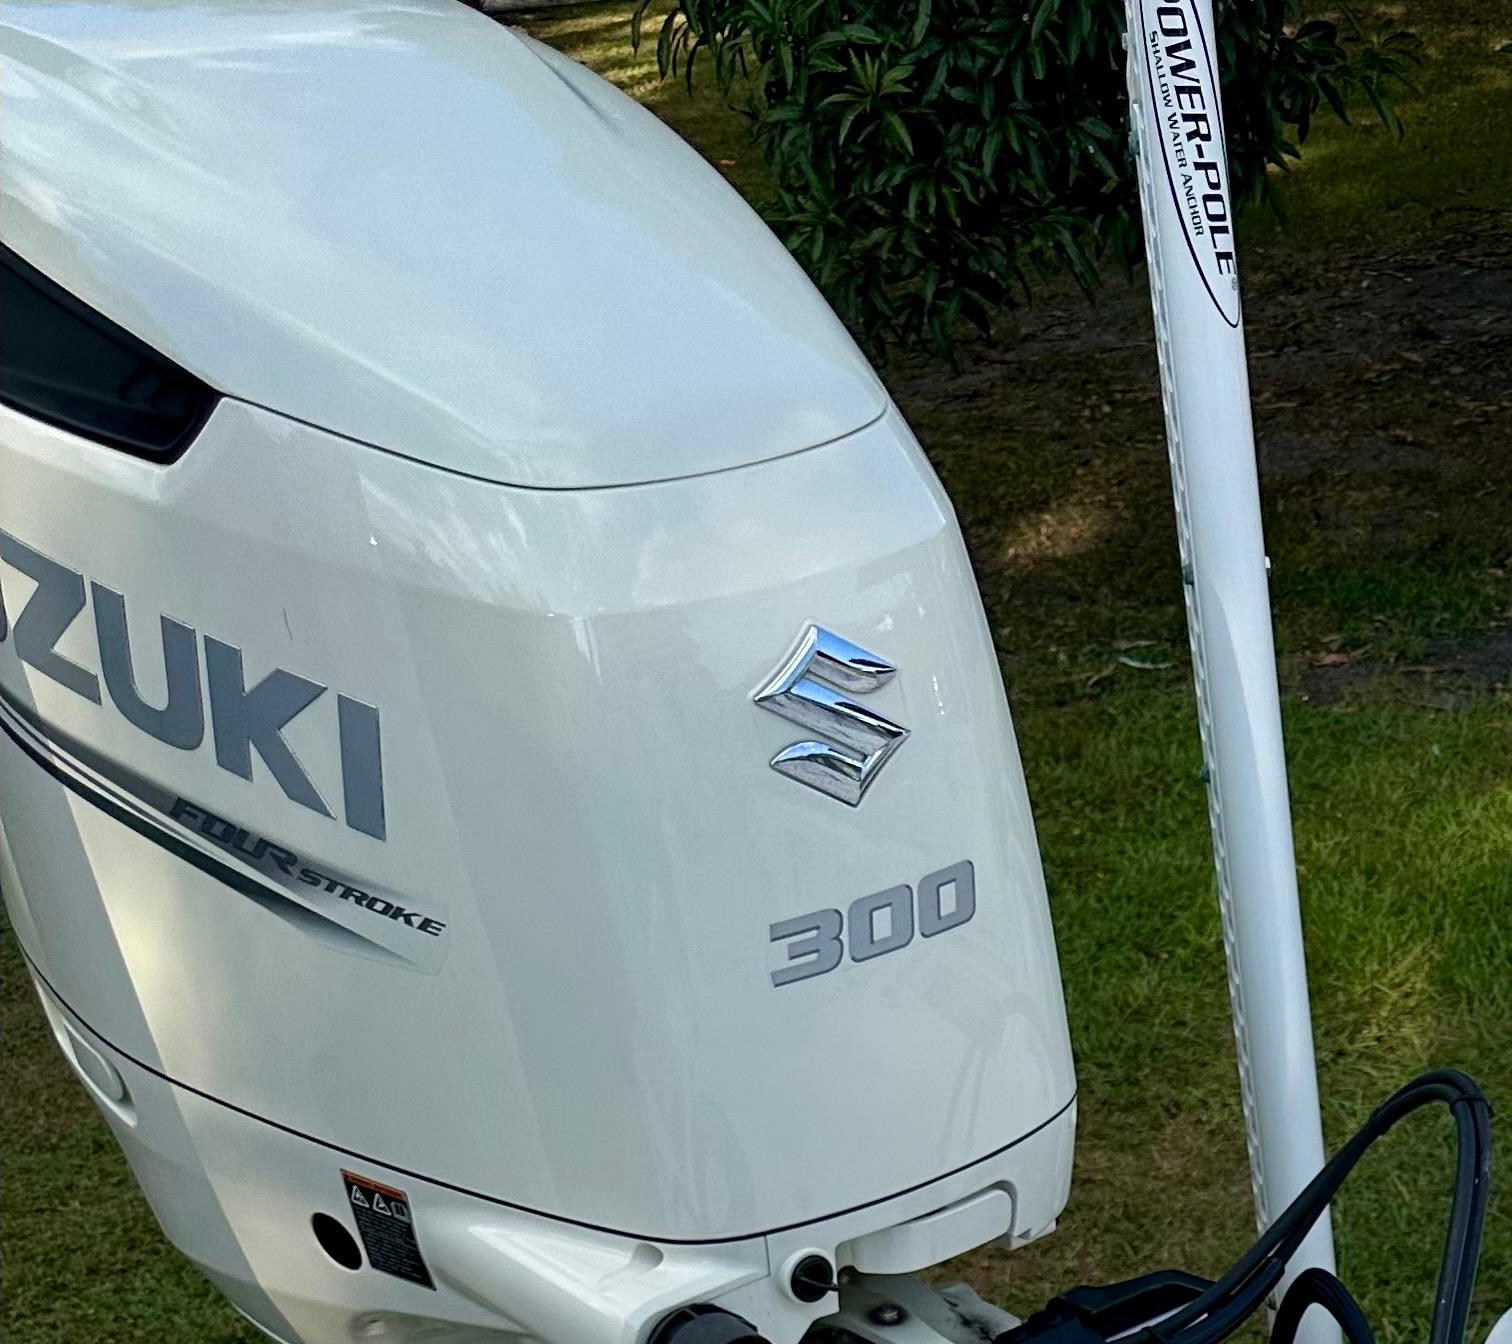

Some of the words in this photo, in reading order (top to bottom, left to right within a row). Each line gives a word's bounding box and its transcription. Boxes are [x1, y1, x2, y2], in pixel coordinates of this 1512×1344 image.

[1149, 31, 1173, 107] SHALLOW
[1167, 112, 1187, 168] WATER
[1180, 173, 1204, 236] ANCHOR
[1156, 0, 1236, 275] OWER-POLE
[0, 526, 386, 841] ZUKI
[769, 859, 976, 988] 300
